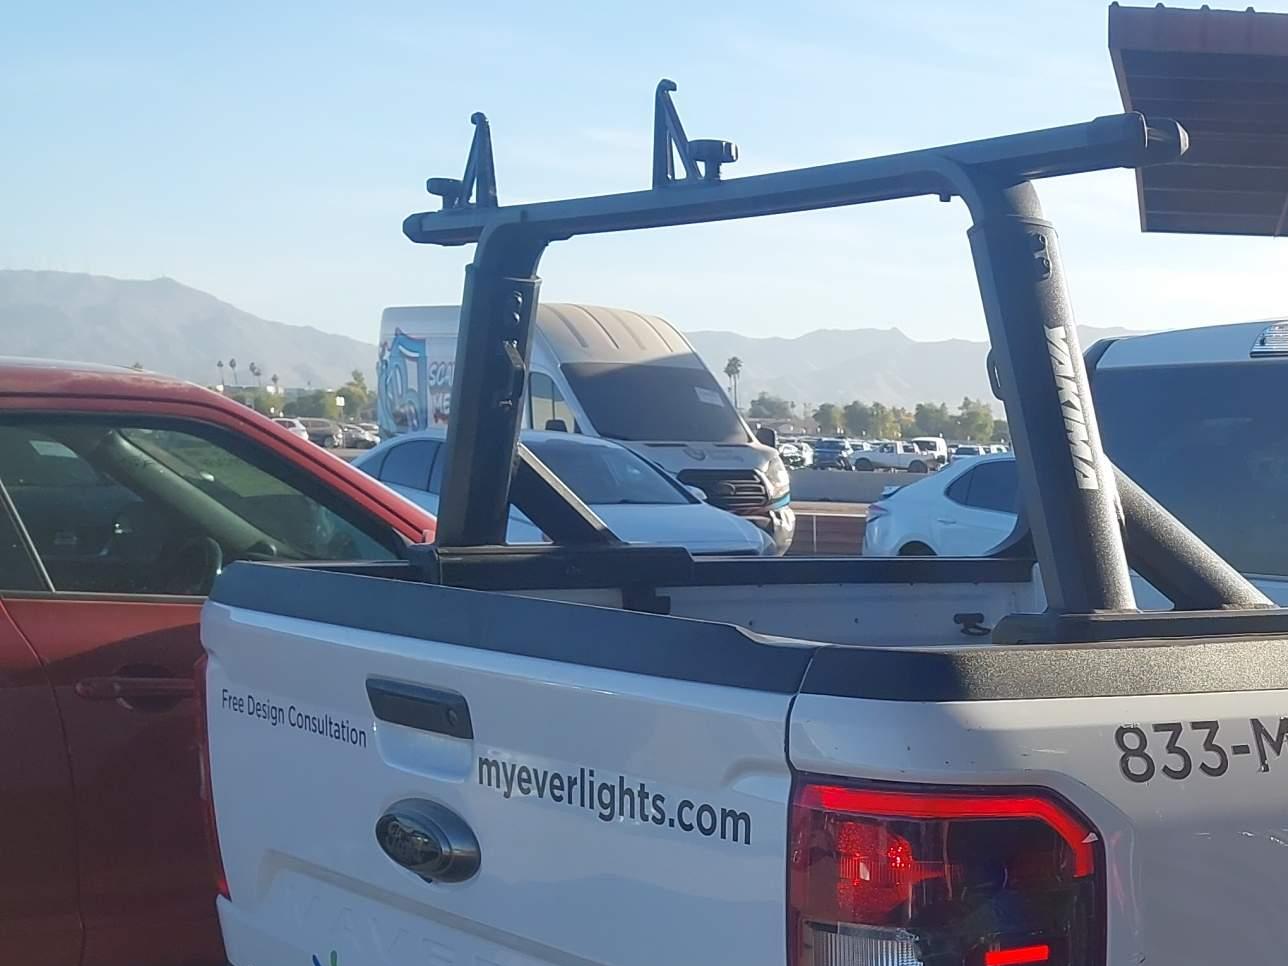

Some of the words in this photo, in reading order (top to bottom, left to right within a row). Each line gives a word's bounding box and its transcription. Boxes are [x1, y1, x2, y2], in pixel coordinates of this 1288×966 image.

[1043, 324, 1100, 490] YAKIMA
[221, 687, 245, 713] Free
[247, 695, 285, 726] Design
[288, 705, 367, 748] Consultation
[478, 755, 751, 845] myeverlights.com
